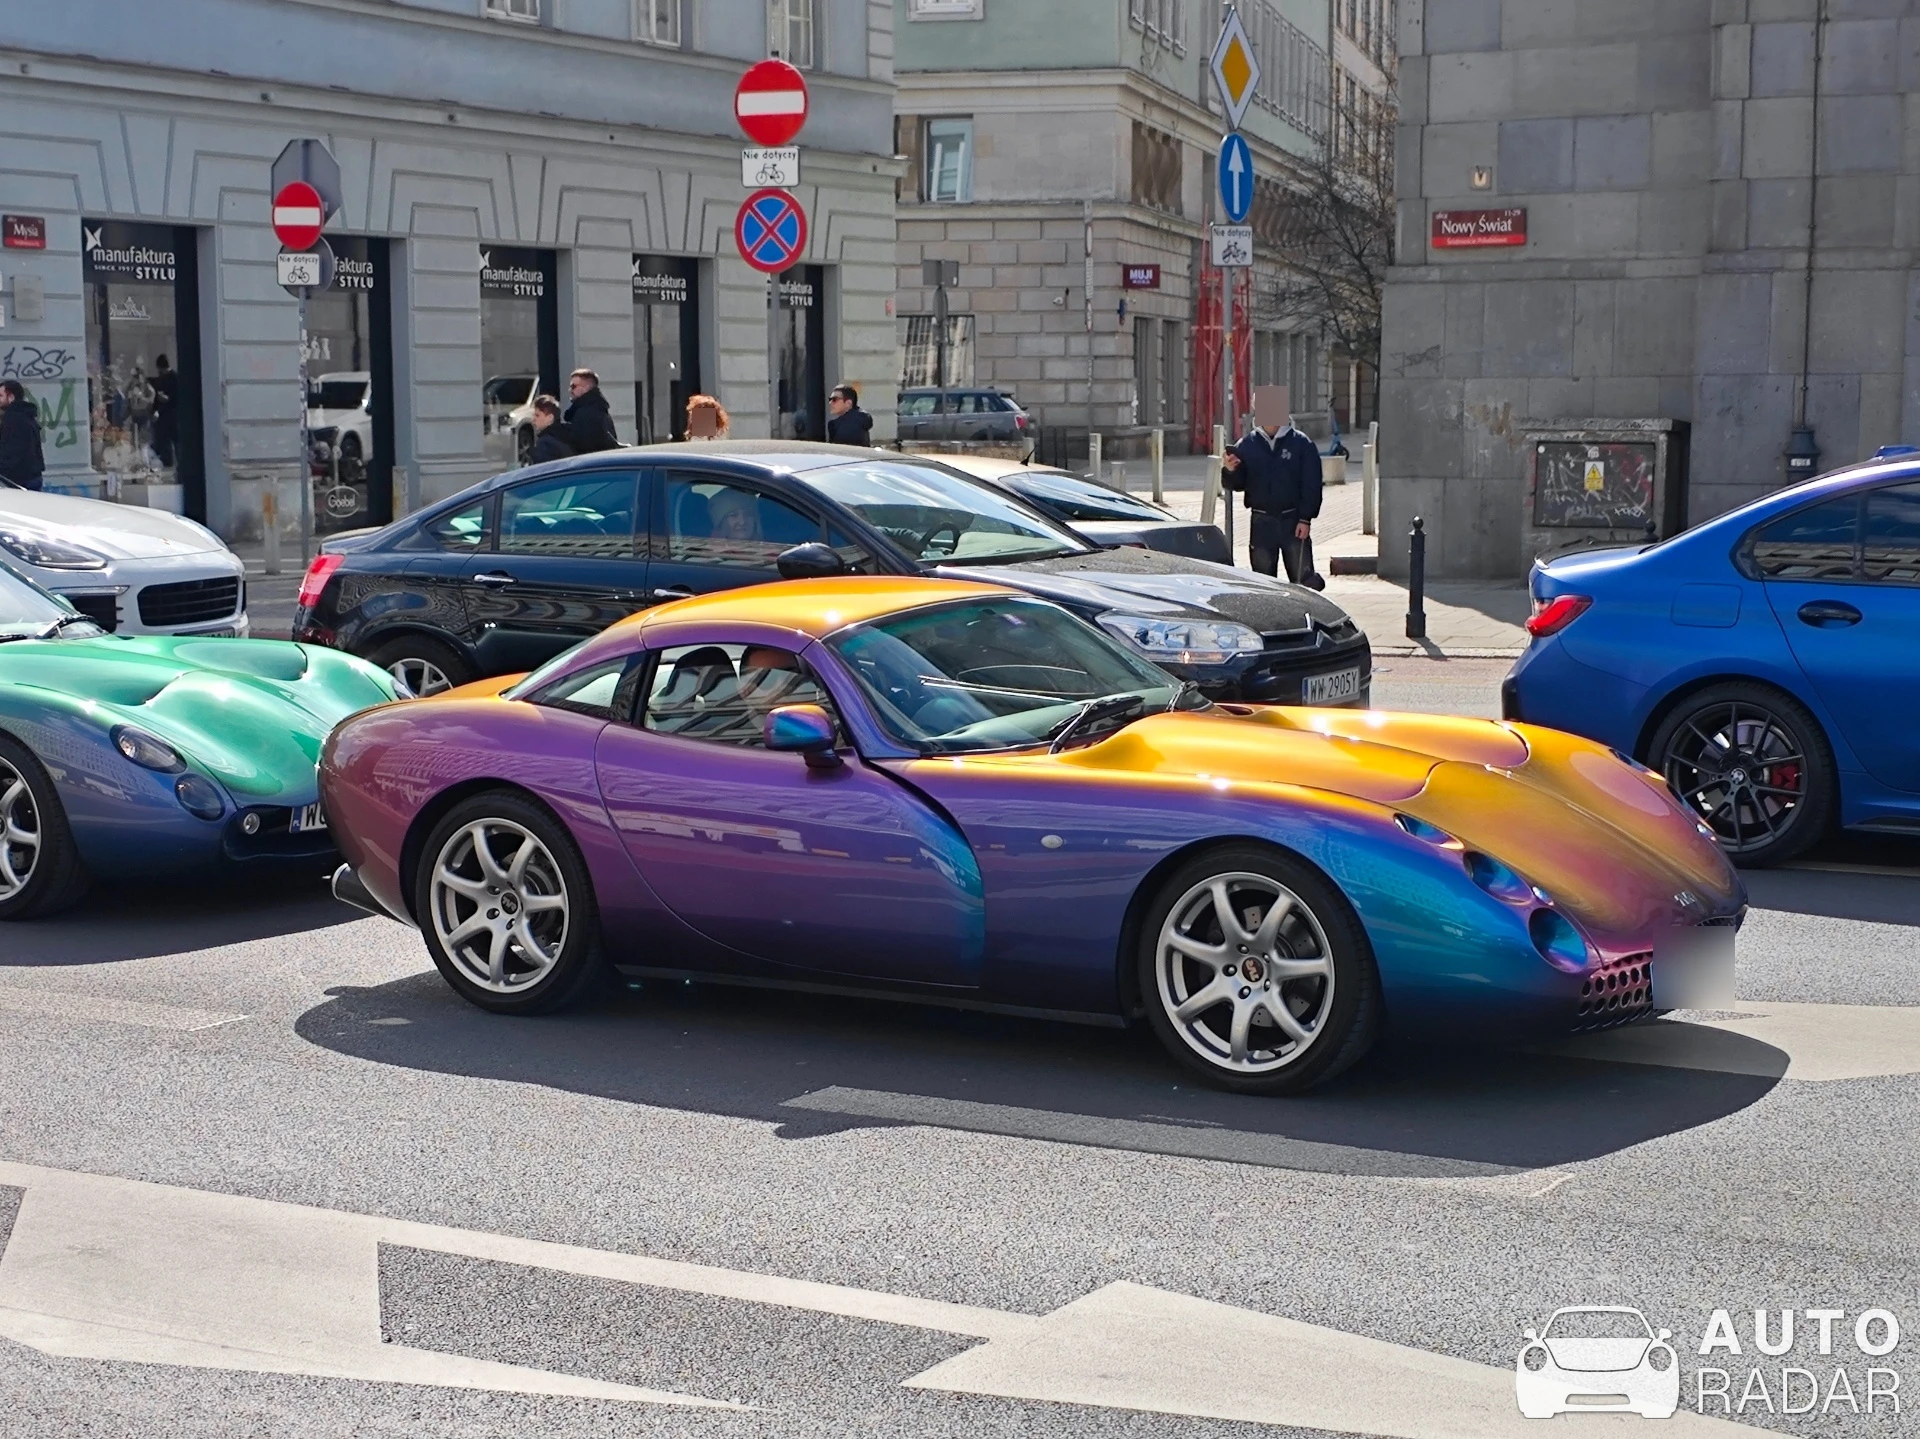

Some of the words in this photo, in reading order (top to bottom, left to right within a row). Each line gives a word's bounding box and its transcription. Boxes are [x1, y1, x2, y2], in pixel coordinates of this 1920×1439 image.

[744, 151, 758, 159] Nie
[763, 150, 796, 161] dotyczy
[1441, 220, 1476, 237] Nowy
[1479, 214, 1512, 233] Świat
[1213, 228, 1225, 236] Nie
[1227, 228, 1251, 239] dotyczy
[93, 246, 175, 265] manufaktura
[293, 256, 318, 264] dotyczy
[136, 266, 176, 281] STYLU
[482, 266, 544, 283] manufaktura
[1129, 269, 1153, 280] MUJI
[339, 275, 374, 289] STYLU
[633, 273, 687, 289] manufaktura
[513, 284, 544, 296] STYLU
[660, 290, 687, 301] STYLU
[789, 295, 813, 307] STYLU
[1328, 671, 1358, 698] 2905Y
